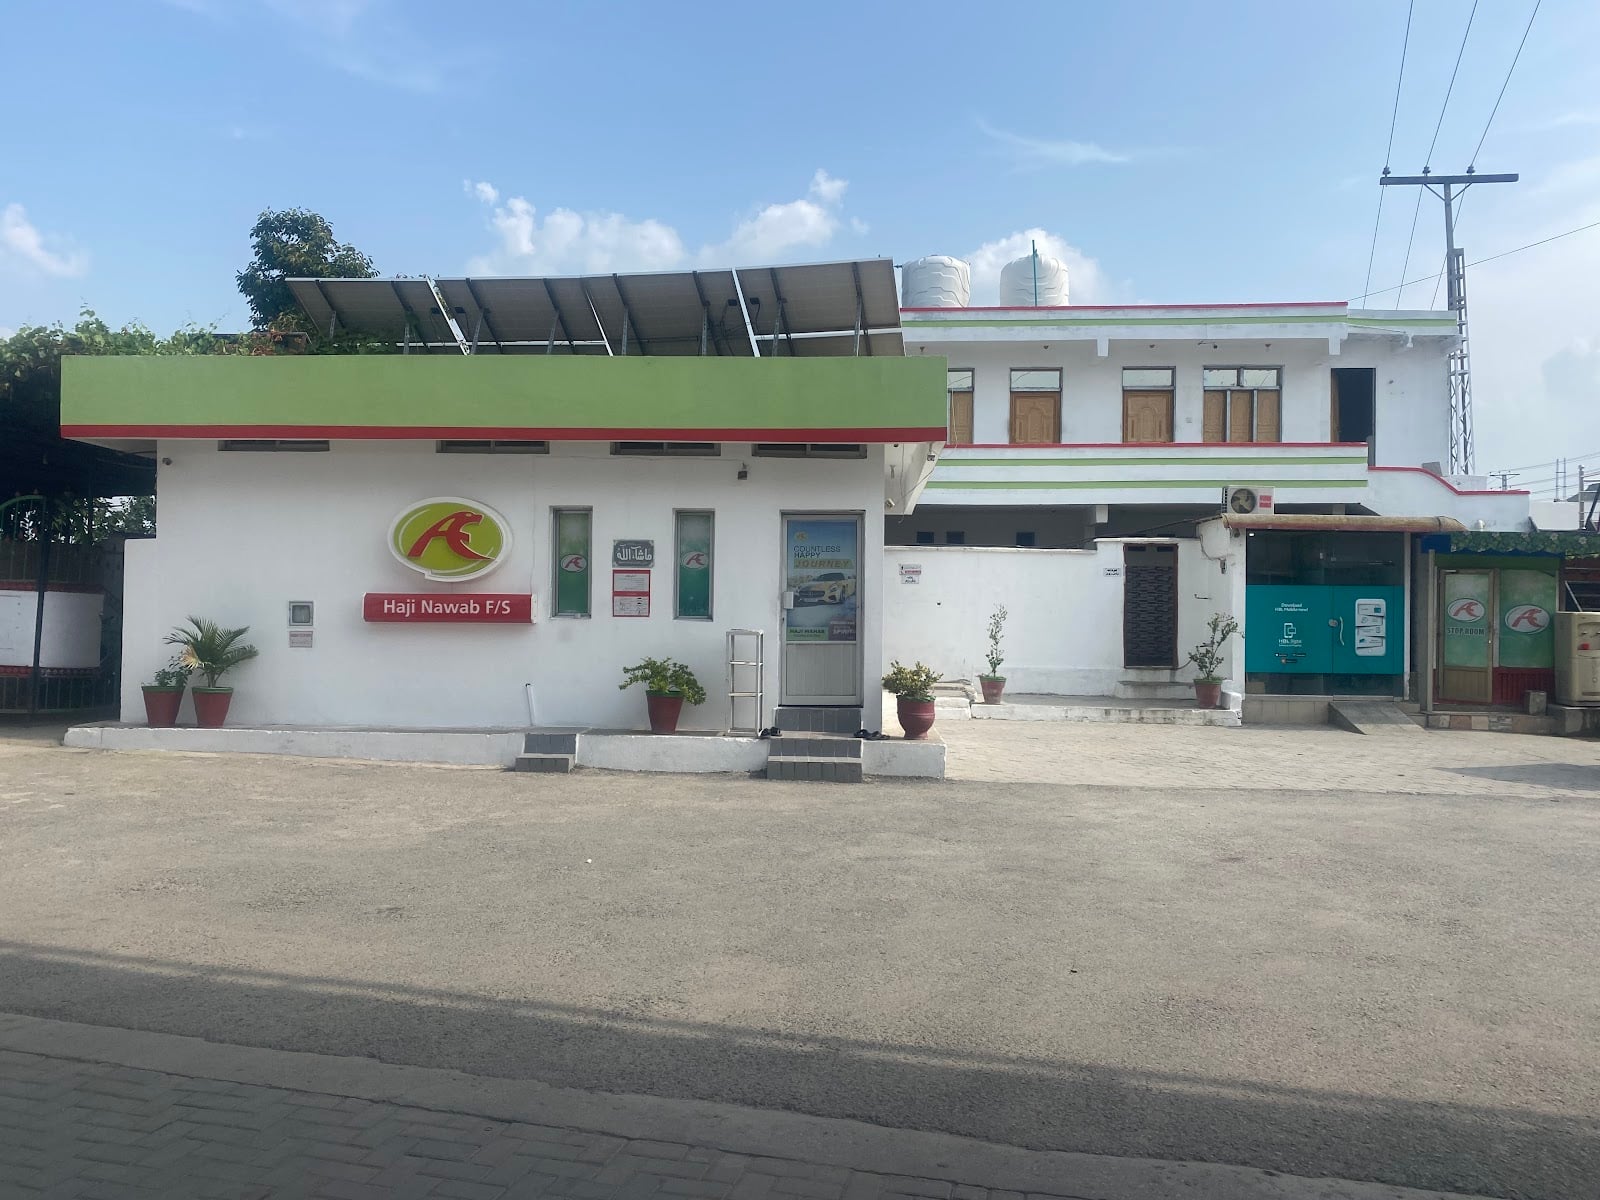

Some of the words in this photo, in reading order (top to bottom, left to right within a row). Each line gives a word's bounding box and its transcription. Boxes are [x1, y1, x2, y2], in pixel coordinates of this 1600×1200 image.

[793, 545, 841, 553] COUNTLESS
[795, 560, 850, 568] JOURNEY
[383, 599, 415, 618] Haji
[421, 599, 480, 614] Nawab
[485, 600, 511, 615] F/S
[1464, 627, 1485, 635] ROOM
